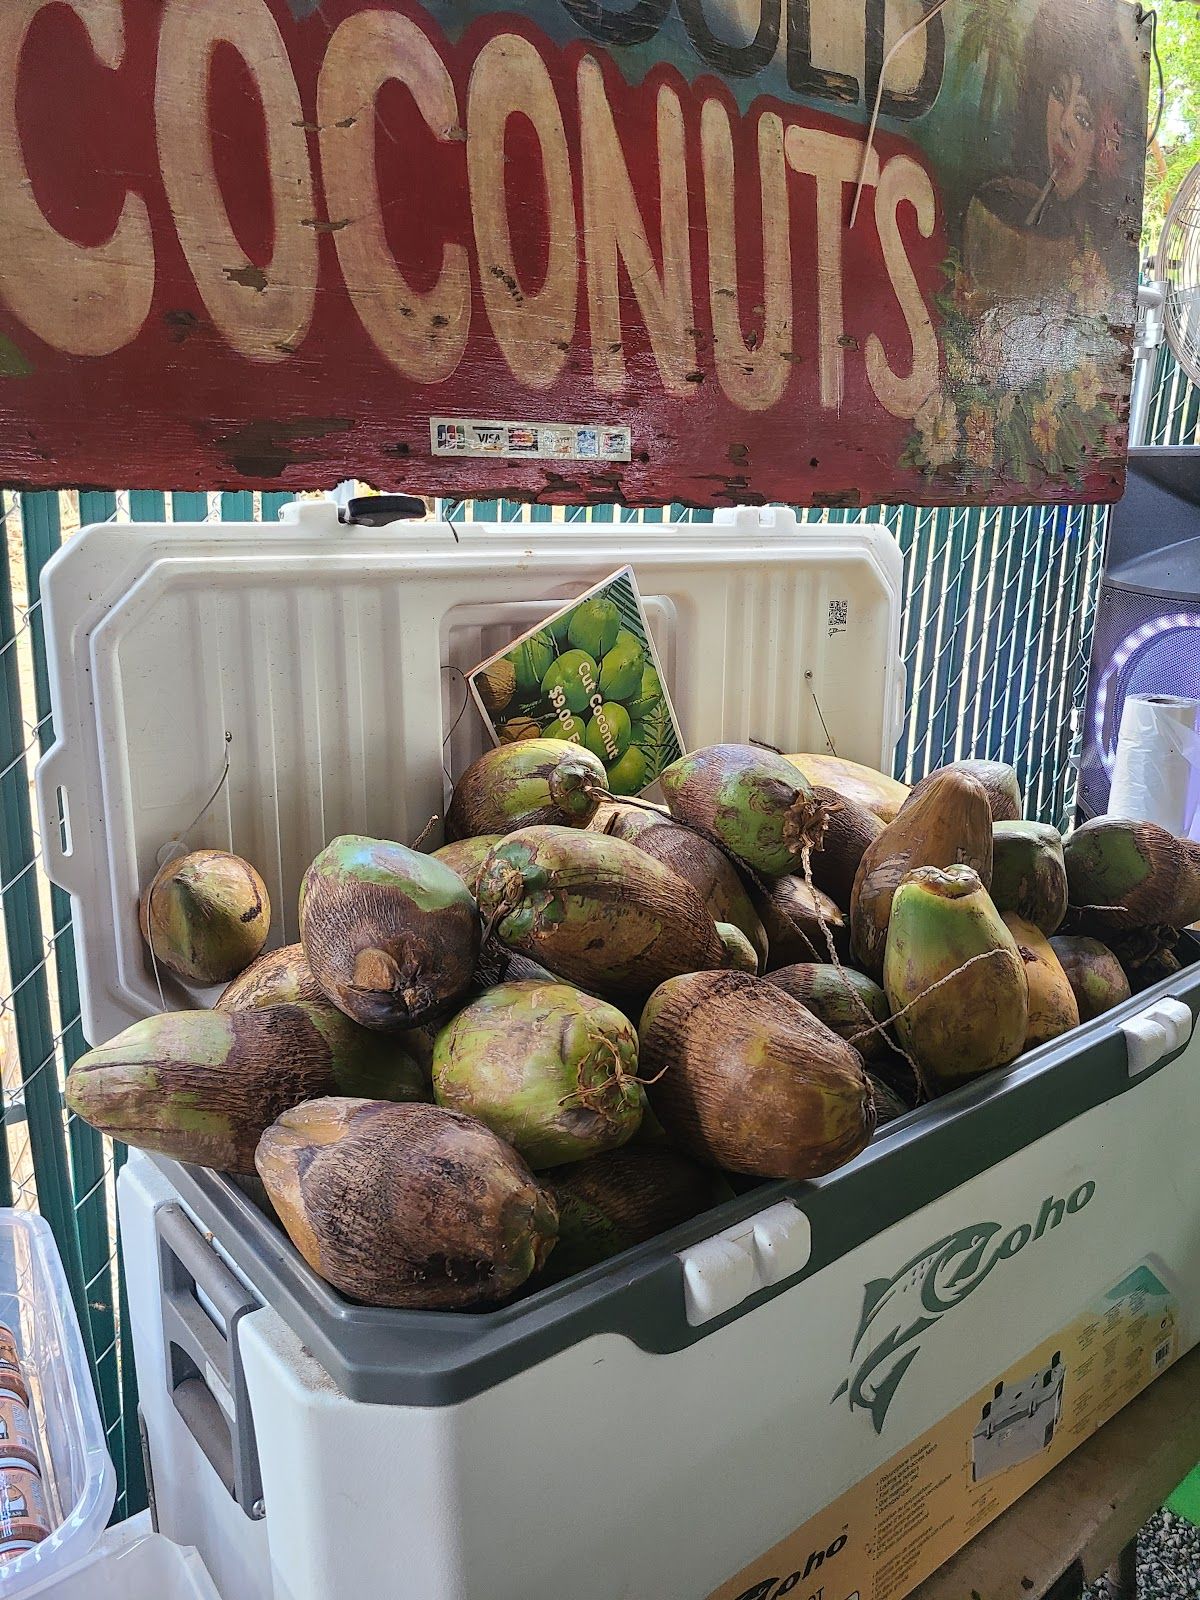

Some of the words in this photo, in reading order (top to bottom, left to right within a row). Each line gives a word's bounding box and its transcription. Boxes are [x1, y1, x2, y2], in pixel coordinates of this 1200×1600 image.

[0, 0, 940, 420] COCONUTS
[477, 432, 501, 444] VISA
[548, 685, 575, 731] $9.00
[578, 661, 597, 694] Cut
[589, 693, 619, 760] Coconut
